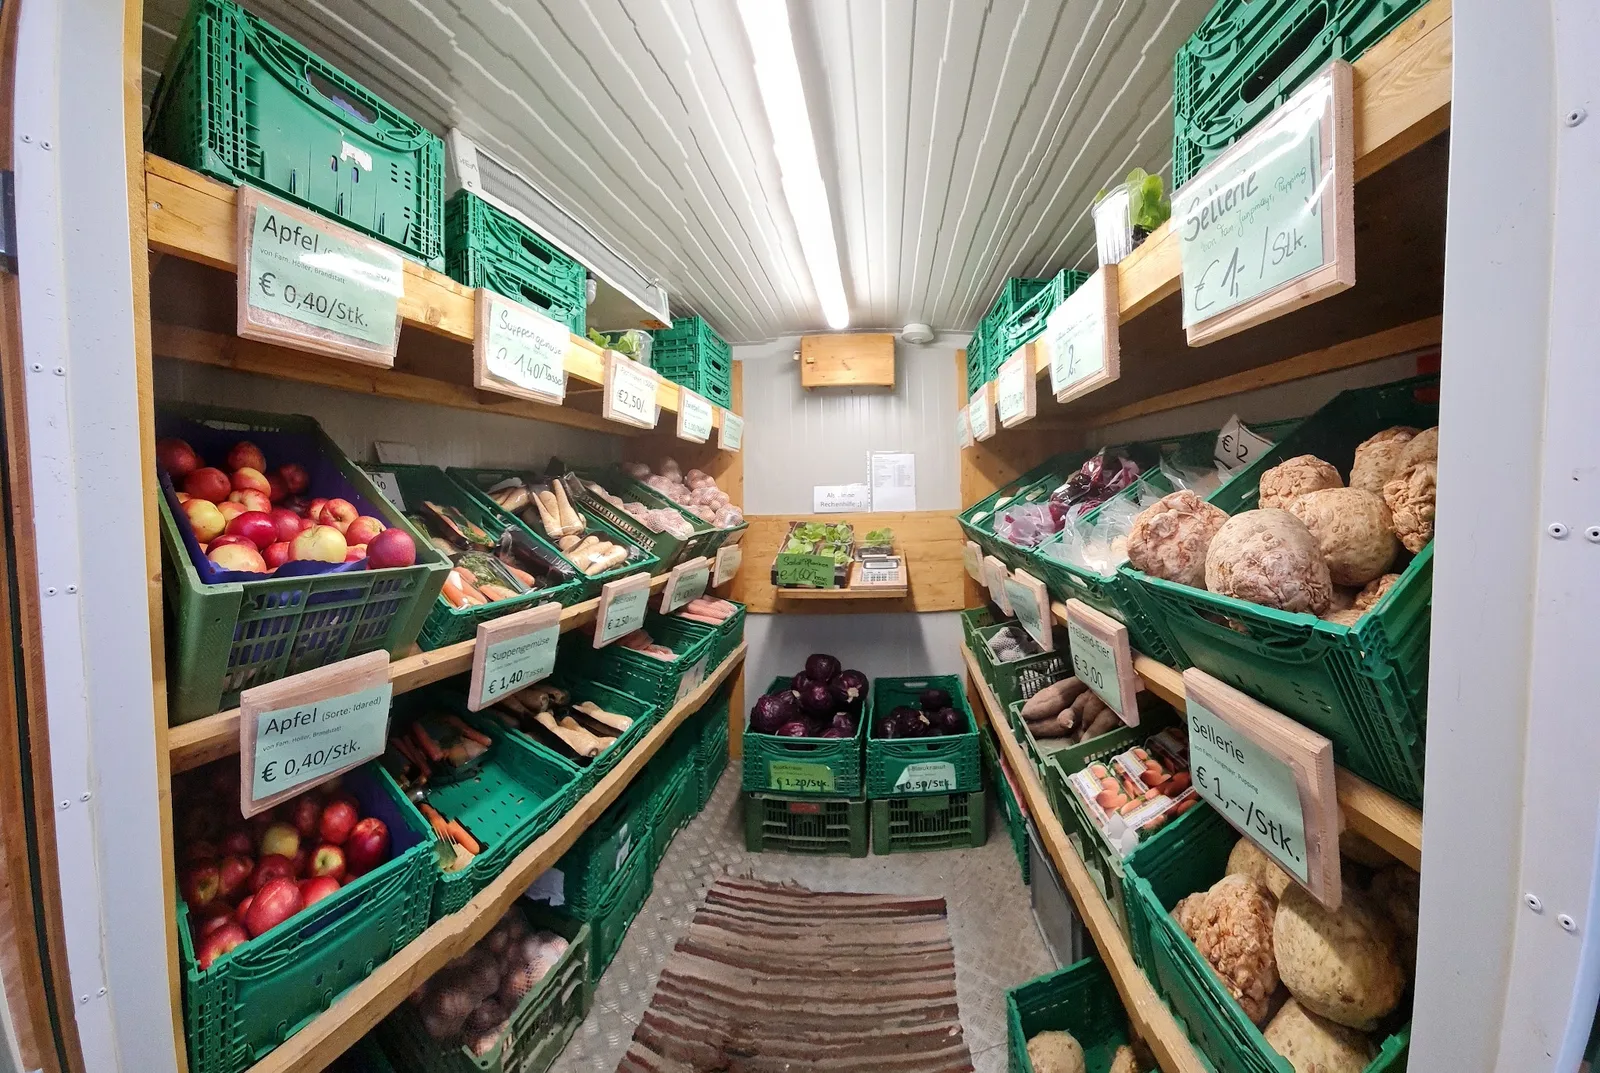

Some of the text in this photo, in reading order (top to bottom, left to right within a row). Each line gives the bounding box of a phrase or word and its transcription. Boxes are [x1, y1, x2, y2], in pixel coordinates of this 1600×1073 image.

[1184, 169, 1259, 243] Sellerie
[260, 248, 273, 257] von
[262, 214, 319, 253] Apfel
[258, 272, 369, 327] € 0,40/Stk.
[1194, 260, 1219, 311] €
[491, 637, 550, 662] Suppengemüse
[488, 679, 497, 694] €
[1074, 654, 1104, 690] € 3,00
[264, 696, 382, 735] Apfel (Sorte: Idared)
[262, 744, 275, 752] von
[275, 739, 290, 748] Fam.
[1192, 716, 1245, 764] Sellerie
[261, 739, 361, 783] € 0,40/Stk.
[785, 778, 830, 788] 1,20/Stk.
[1196, 765, 1208, 789] €
[1213, 776, 1300, 863] 1,--/Stk.
